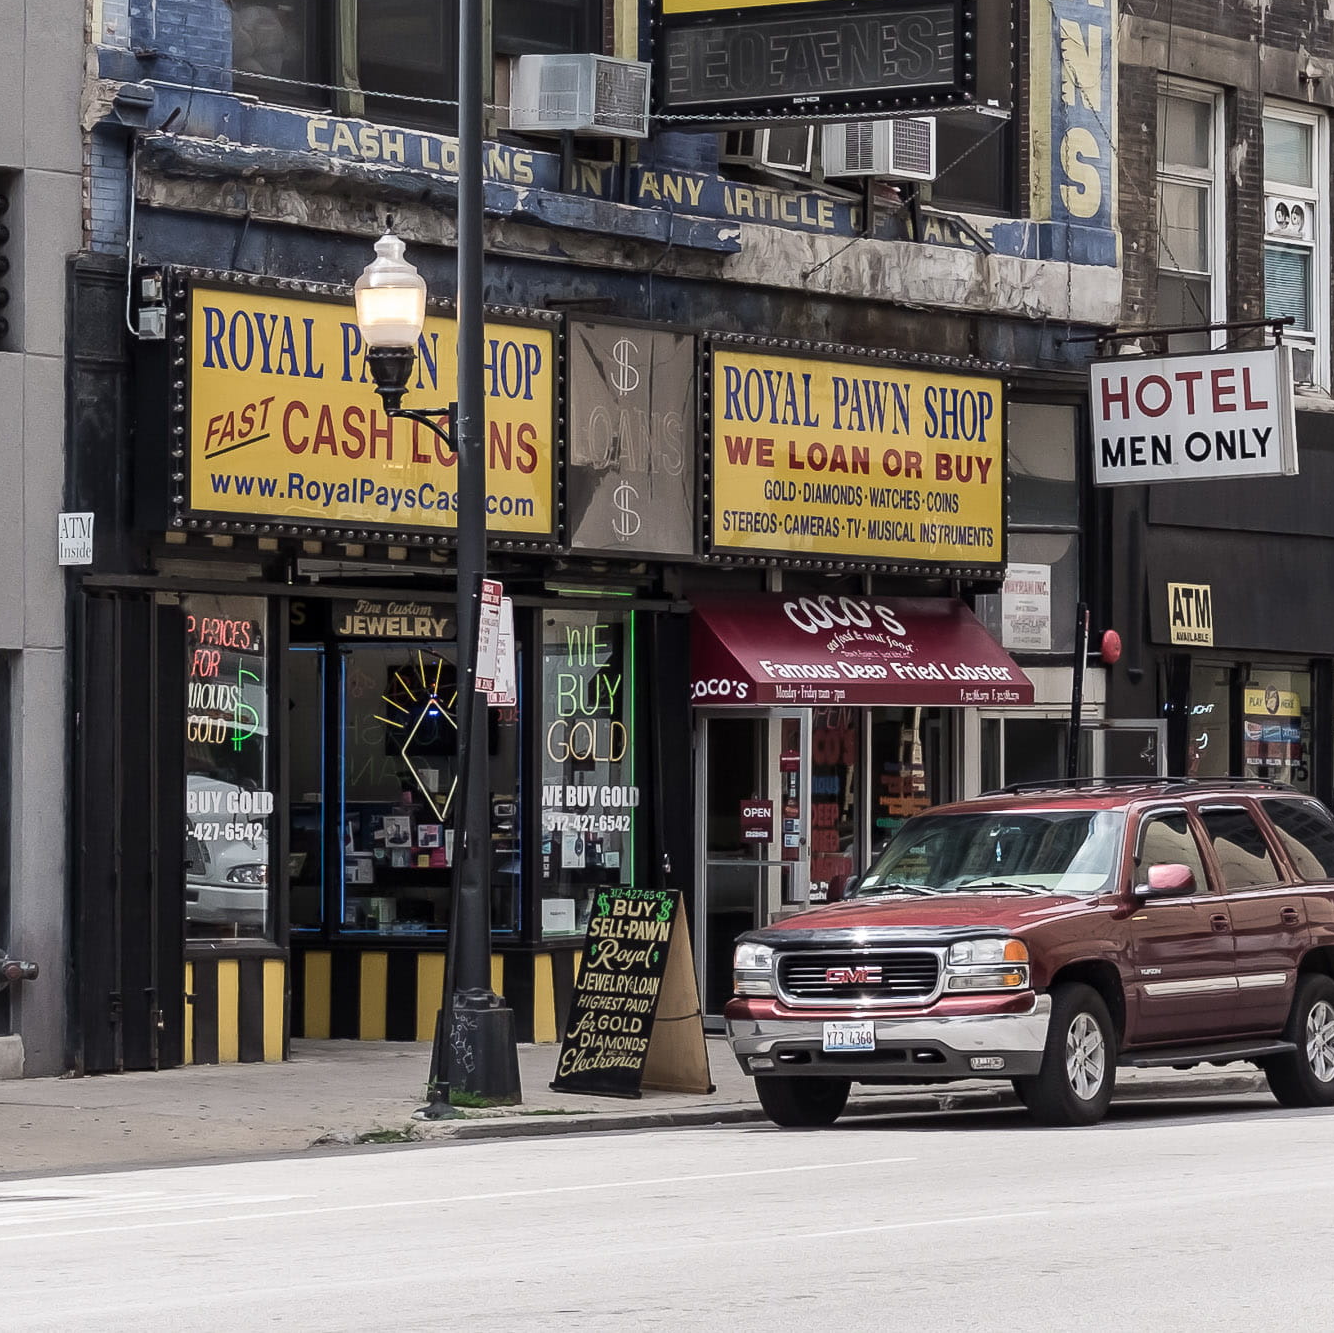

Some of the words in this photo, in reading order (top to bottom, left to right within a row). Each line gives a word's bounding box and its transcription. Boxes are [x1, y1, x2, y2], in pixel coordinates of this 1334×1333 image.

[305, 118, 406, 164] CASH
[420, 135, 534, 185] LONS
[637, 169, 705, 207] ANY
[202, 305, 325, 381] ROYAL
[723, 364, 820, 428] ROYAL
[831, 376, 912, 437] PAWN
[923, 385, 994, 443] SHOP
[1100, 365, 1270, 422] HOTEL
[203, 396, 276, 453] FAST
[282, 399, 395, 463] CASH
[412, 408, 539, 474] LONS
[1101, 433, 1173, 468] MEN
[1184, 426, 1273, 463] ONLY
[723, 434, 776, 467] WE
[788, 440, 871, 476] LOAN
[881, 447, 924, 480] OR
[934, 452, 994, 485] BUY
[763, 479, 797, 503] GOLD
[802, 483, 864, 509] DIAMONDS
[868, 486, 921, 512] WATCHES
[926, 490, 960, 515] COINS
[58, 516, 92, 540] ATM
[722, 509, 778, 534] STEREOS
[783, 513, 840, 539] CAMERAS
[845, 516, 862, 540] TV
[866, 518, 916, 544] MUSICAL
[919, 522, 994, 549] INSTRUMENTS
[59, 543, 92, 559] Inside
[354, 599, 382, 615] Fine
[387, 600, 434, 616] Custom
[1172, 586, 1212, 629] ATM
[339, 615, 450, 638] JEWELRY
[1176, 631, 1209, 643] AVAILABLE
[566, 624, 611, 668] WE
[190, 649, 221, 678] FOR
[758, 659, 841, 680] Famous
[889, 661, 944, 681] Fried
[940, 662, 1013, 682] Lobster
[557, 673, 622, 718] BUY
[187, 714, 227, 744] GOLD
[546, 719, 628, 763] GOLD
[186, 791, 223, 814] BUY
[226, 791, 274, 815] GOLD
[541, 785, 564, 807] WE
[566, 785, 598, 807] BUY
[600, 785, 640, 808] GOLD
[546, 814, 631, 832] 312-427-6542
[743, 807, 771, 818] OPEN
[612, 899, 657, 917] BUY
[587, 938, 656, 971] Royal
[577, 972, 629, 994] JEWELRY
[633, 976, 661, 995] LOAN
[825, 965, 883, 984] GMC
[577, 993, 625, 1012] HIGHEST
[624, 993, 656, 1014] PAID!
[567, 1011, 598, 1039] for
[597, 1015, 643, 1034] GOLD
[579, 1032, 649, 1053] DIAMONDS
[558, 1047, 642, 1078] Electronics
